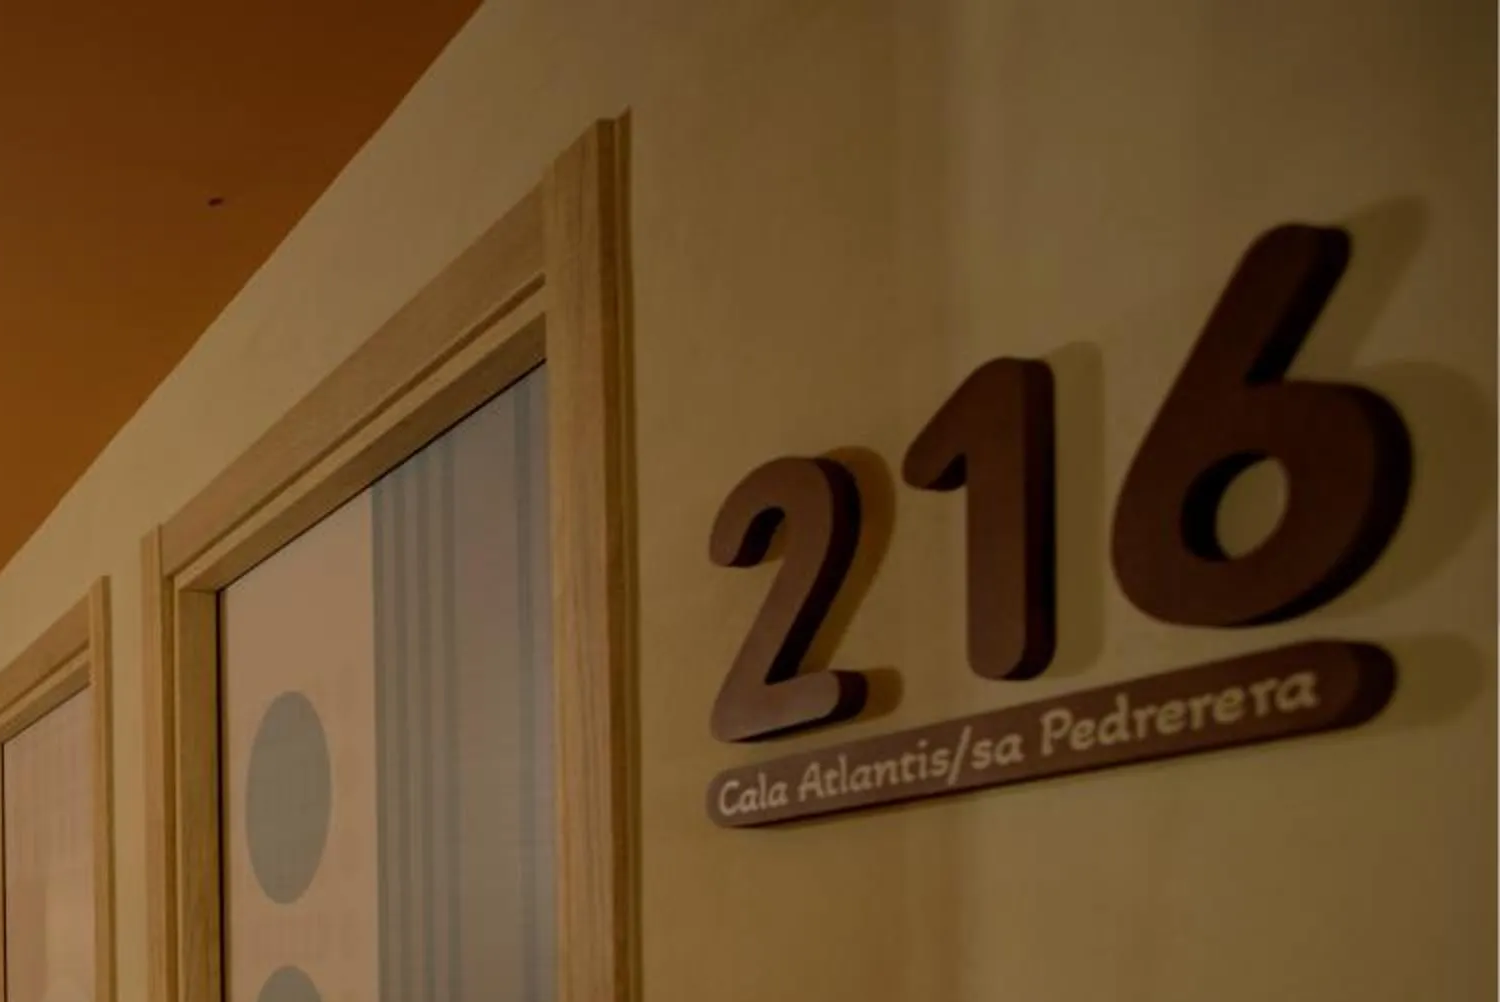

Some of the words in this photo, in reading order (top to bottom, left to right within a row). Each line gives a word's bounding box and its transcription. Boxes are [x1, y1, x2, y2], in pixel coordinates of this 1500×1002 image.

[709, 223, 1413, 743] 216
[716, 777, 788, 817] Cala
[798, 726, 1025, 801] Atlantis/sa
[1039, 665, 1322, 758] Pedrerera
